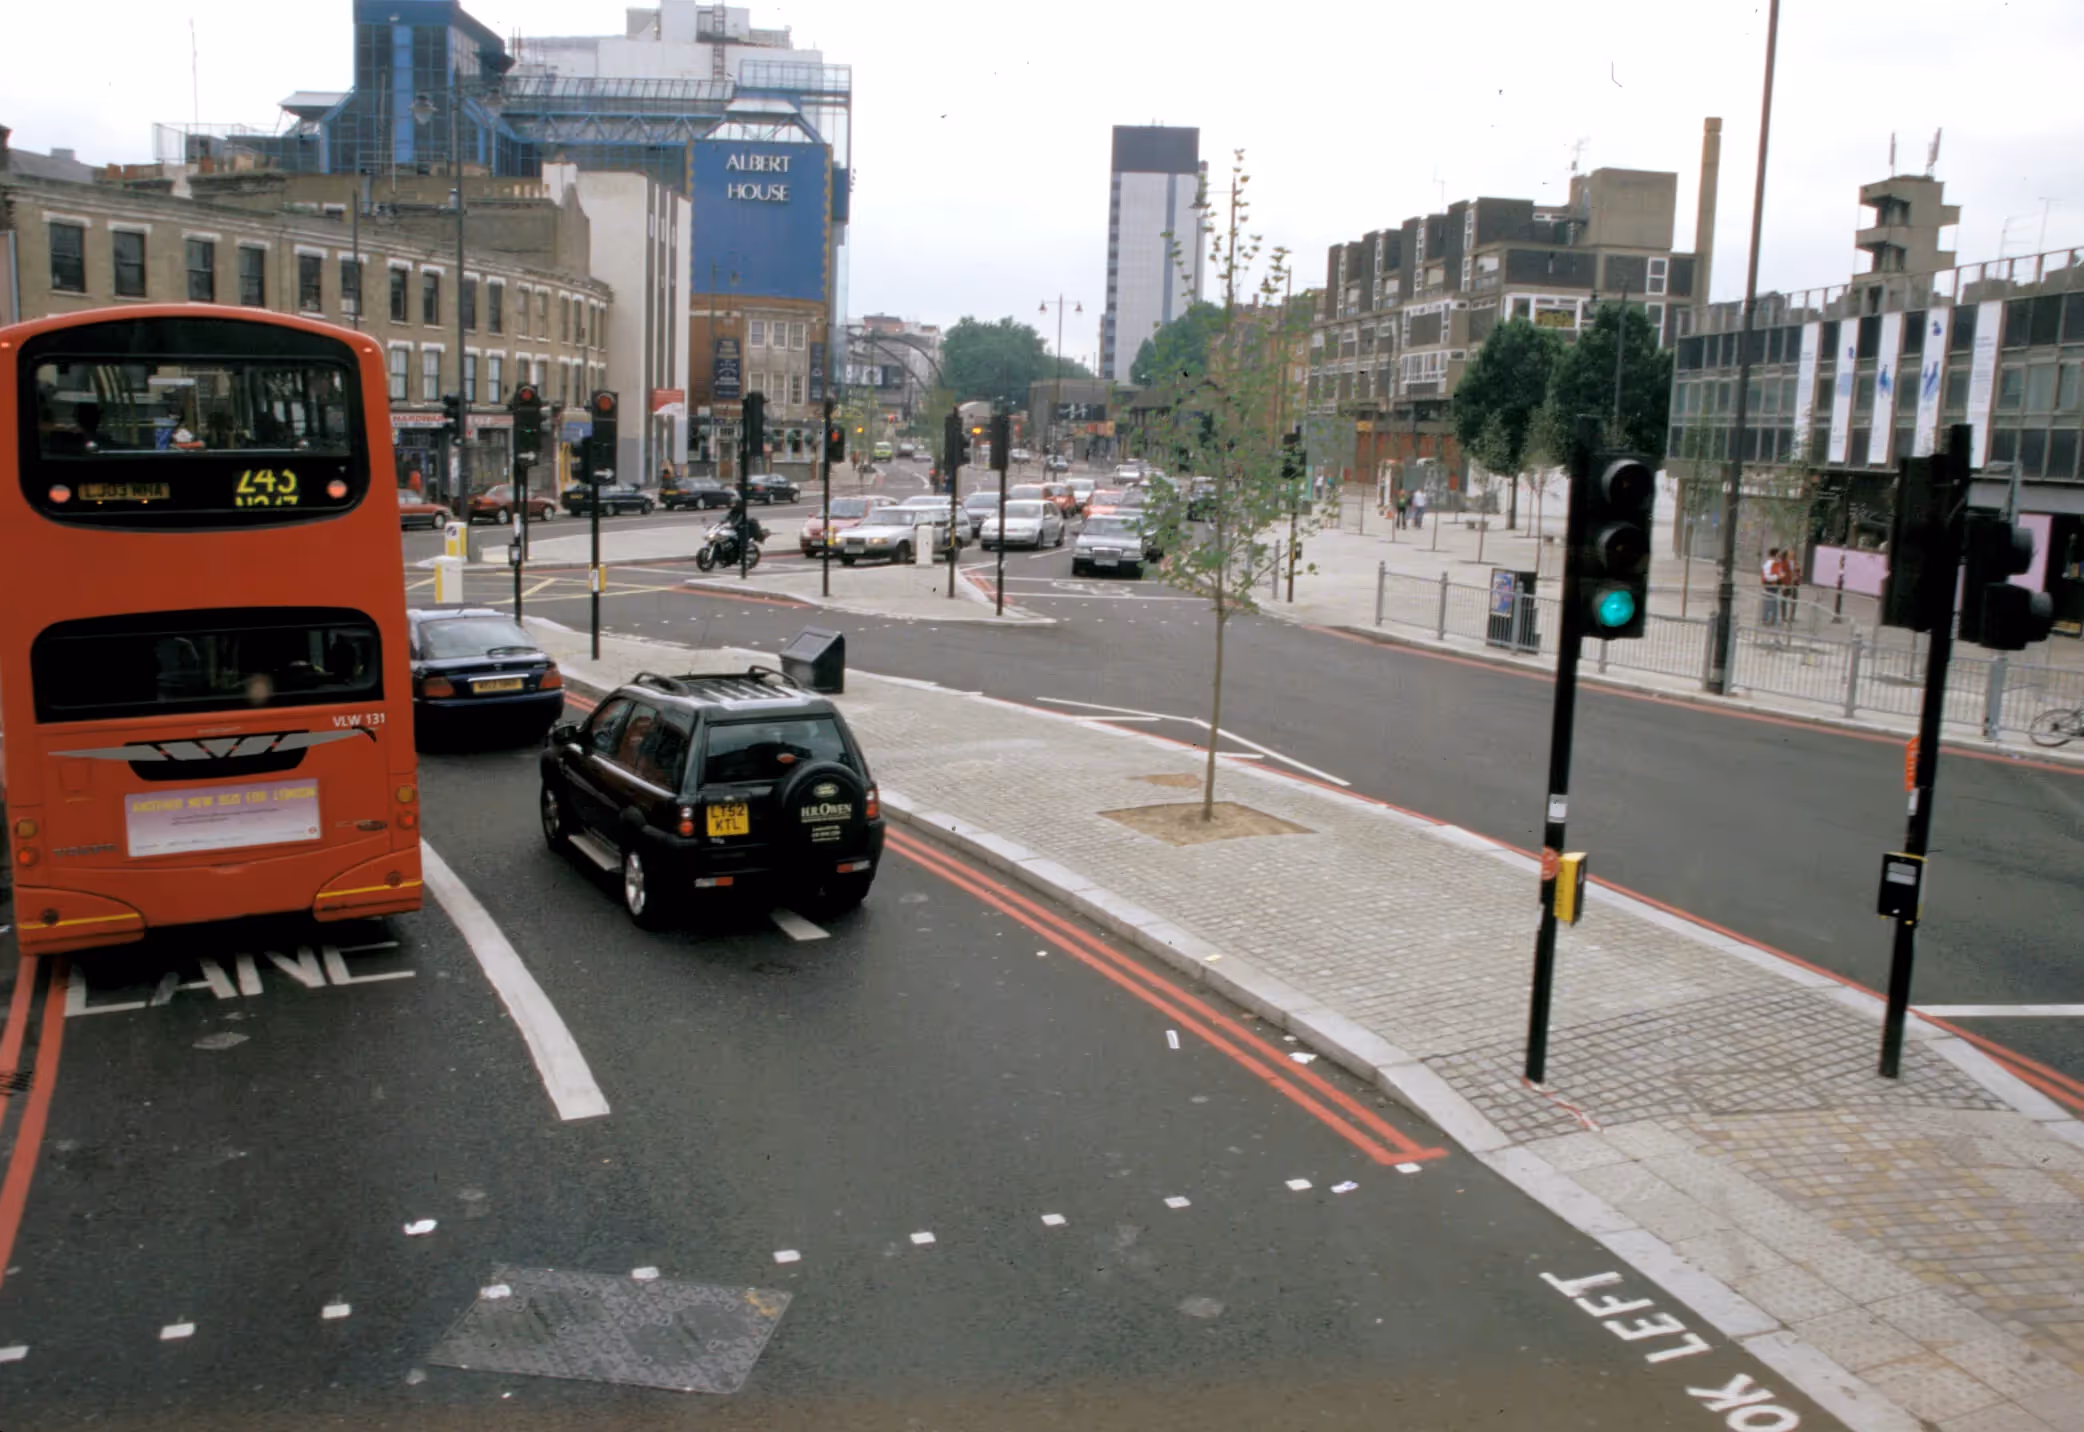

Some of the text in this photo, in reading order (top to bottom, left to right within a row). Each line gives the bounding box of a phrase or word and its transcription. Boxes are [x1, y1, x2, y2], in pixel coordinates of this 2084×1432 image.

[726, 154, 792, 172] ALBERT
[727, 184, 790, 201] HOUSE
[332, 712, 385, 727] VLW 131
[710, 804, 745, 819] LT52
[715, 818, 741, 832] KTL
[1538, 1271, 1713, 1364] LEFT
